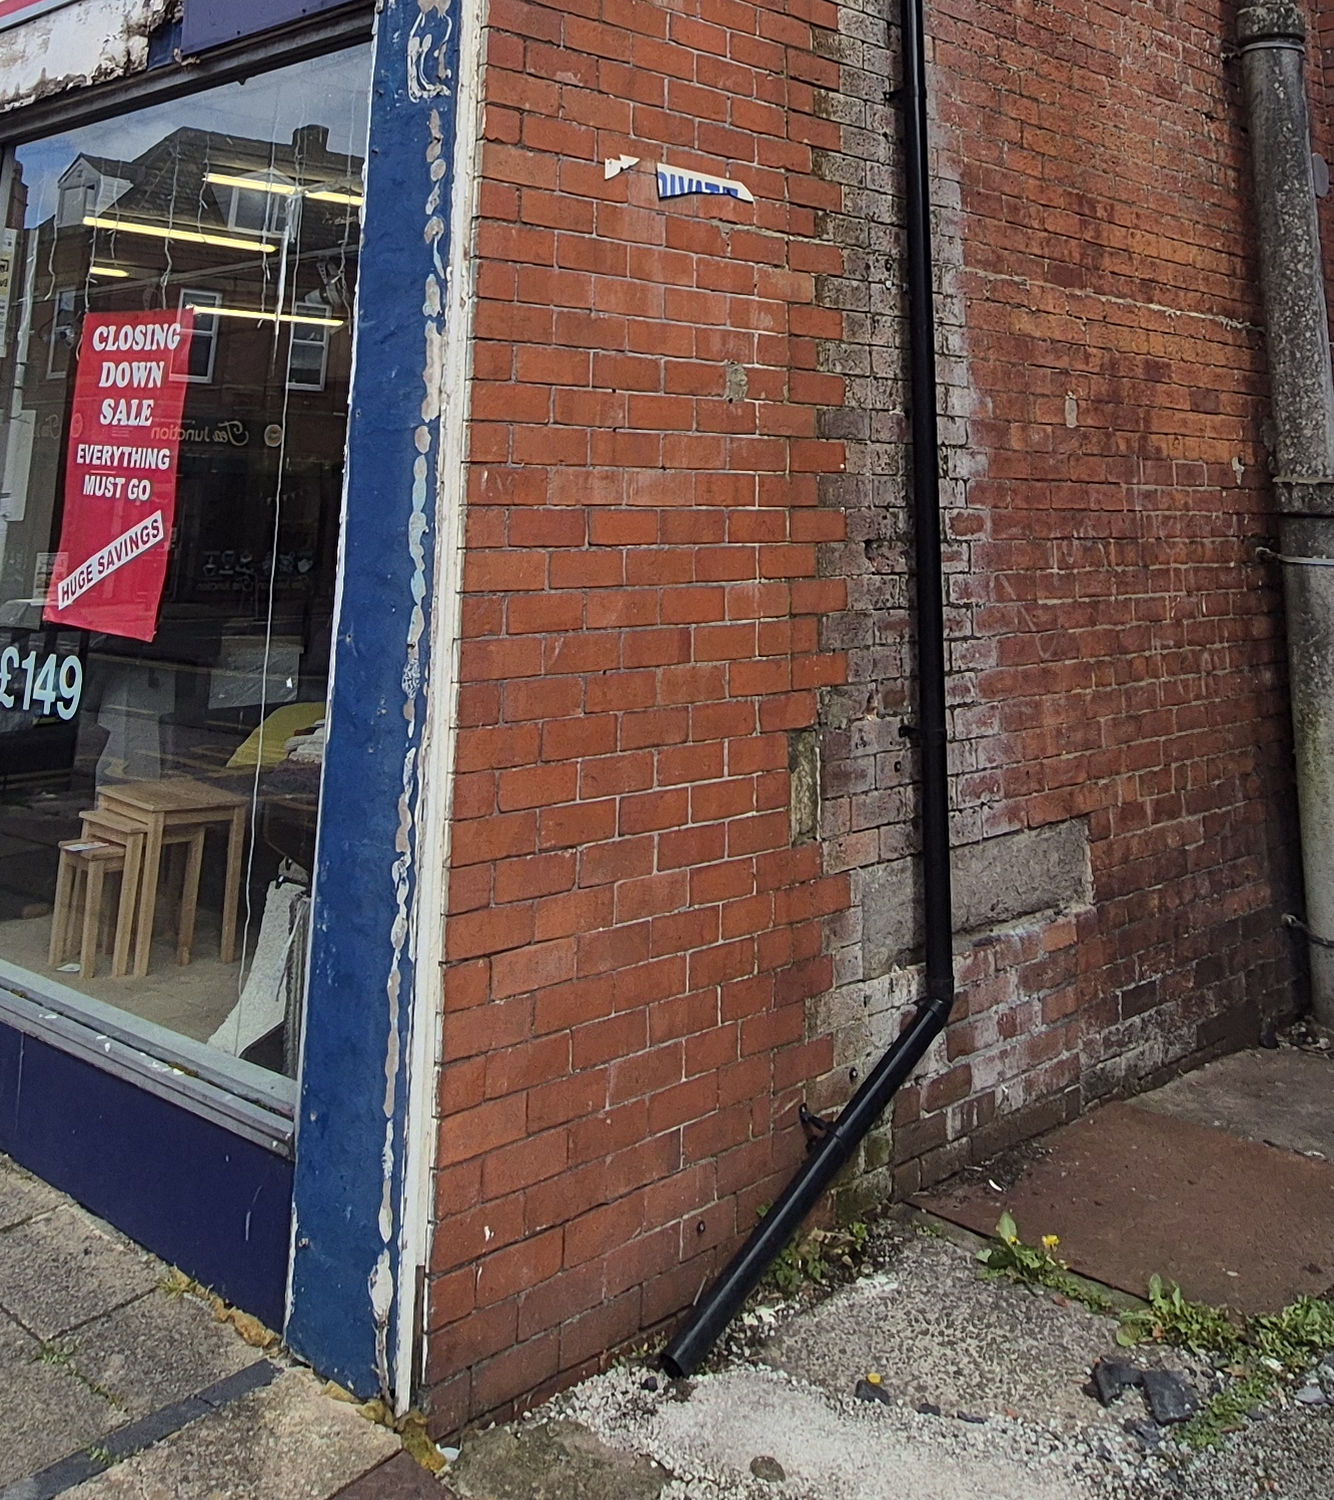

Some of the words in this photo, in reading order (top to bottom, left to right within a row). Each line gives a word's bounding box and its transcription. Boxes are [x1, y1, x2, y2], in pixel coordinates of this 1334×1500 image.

[92, 323, 181, 351] CLOSING
[98, 361, 164, 388] DOWN
[100, 398, 154, 426] SALE
[76, 444, 170, 470] EVERYTHING
[83, 475, 125, 498] MUST
[128, 479, 151, 501] GO
[62, 564, 94, 604] HUGE
[97, 518, 160, 575] SAVINGS
